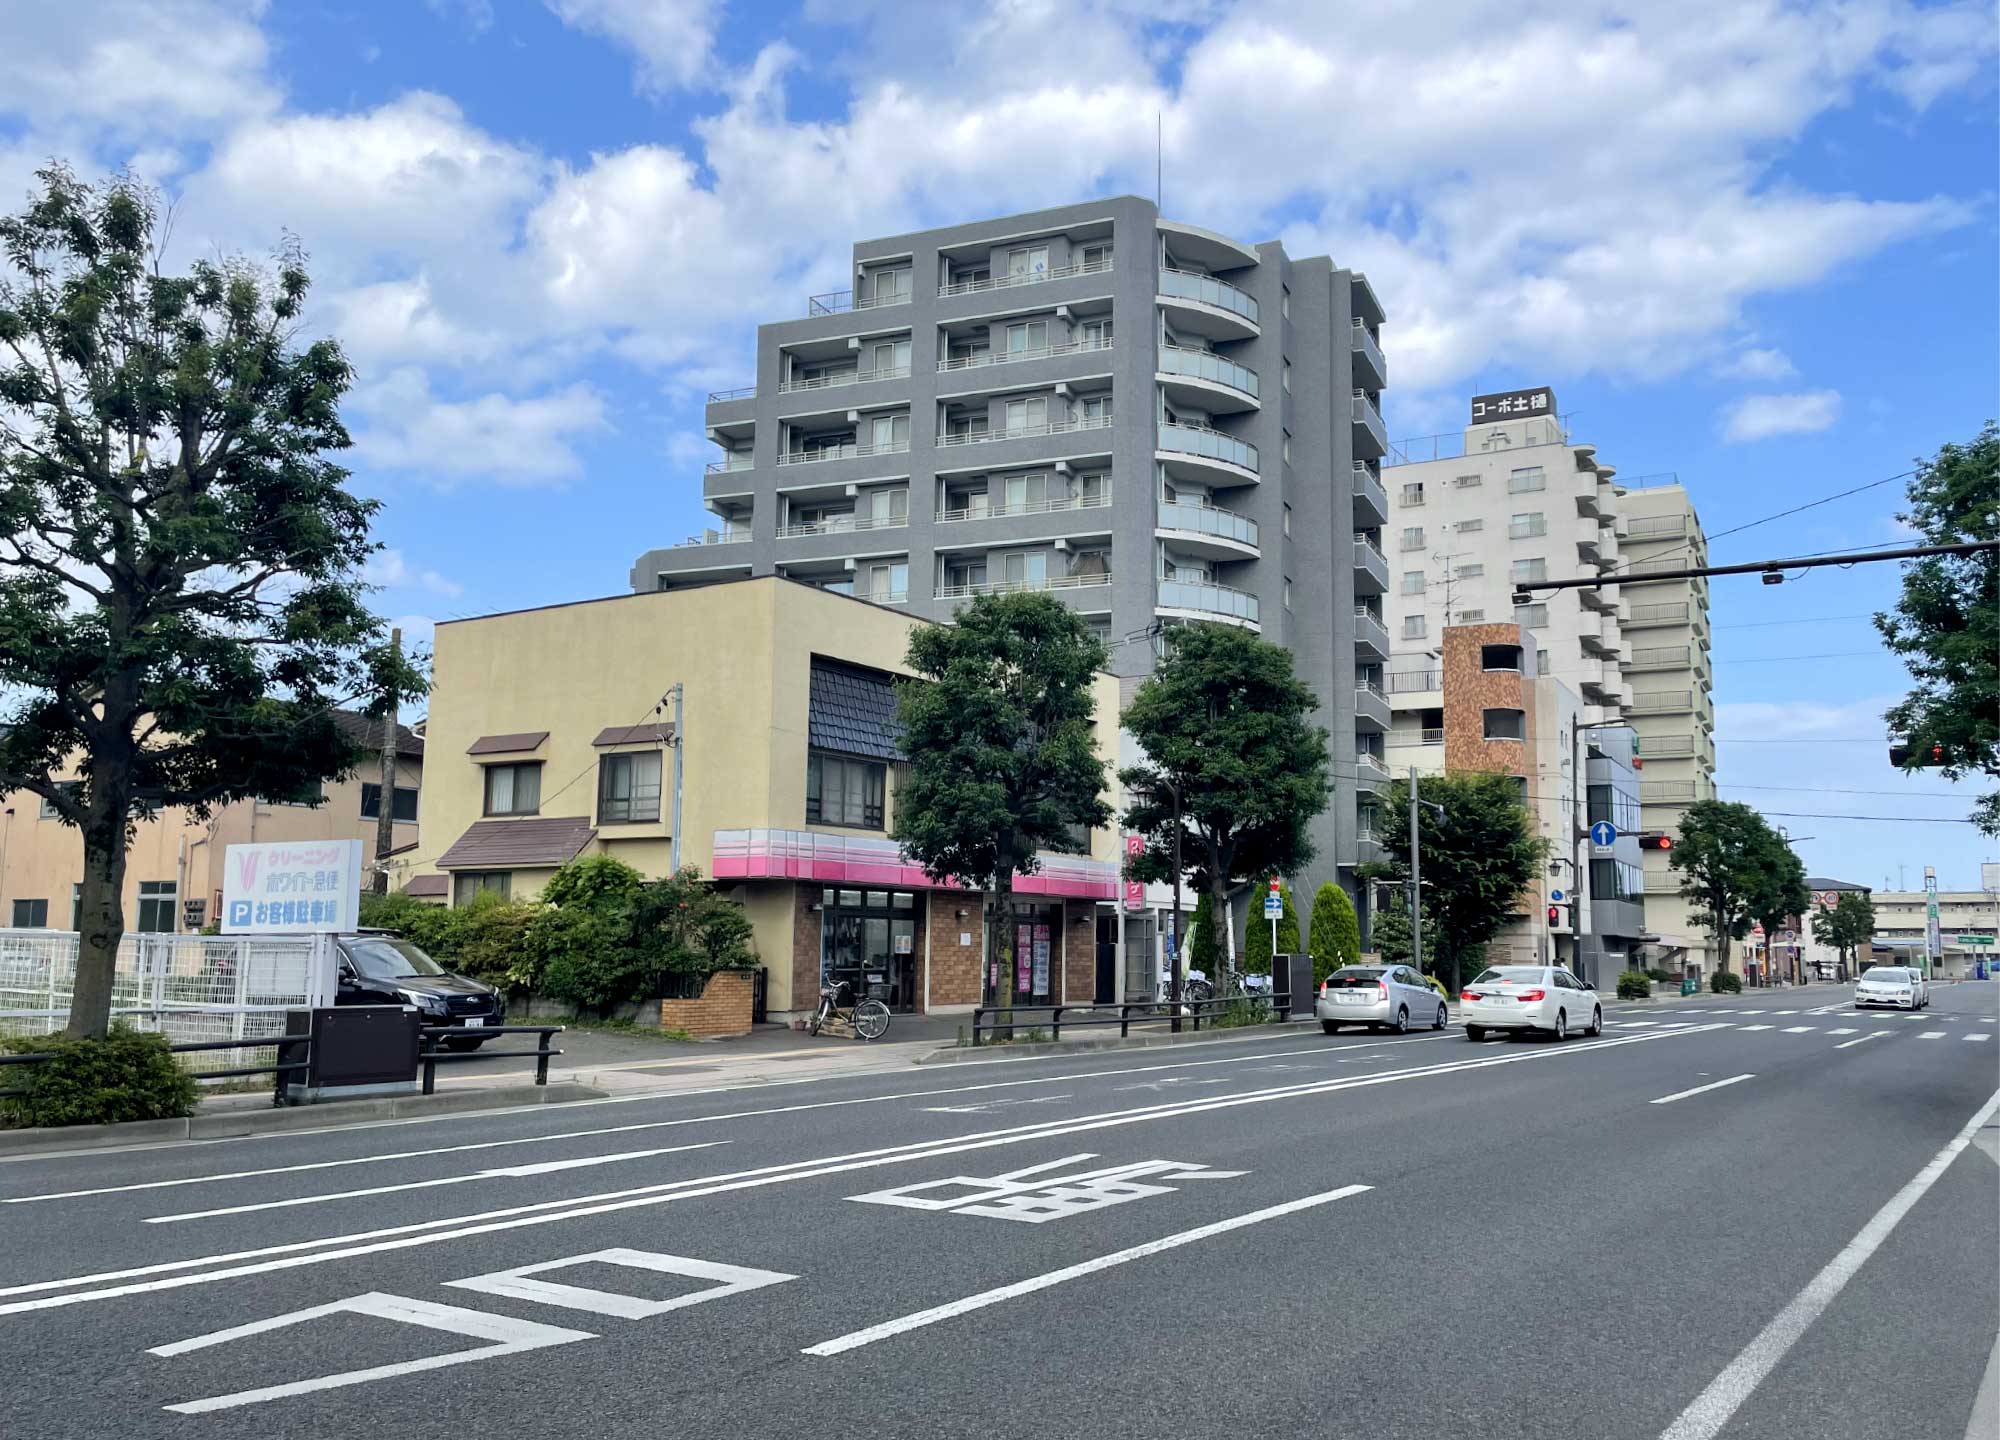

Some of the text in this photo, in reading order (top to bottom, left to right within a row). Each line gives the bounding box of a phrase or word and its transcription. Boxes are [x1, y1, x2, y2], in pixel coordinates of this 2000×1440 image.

[268, 848, 340, 866] クリーニング
[266, 871, 339, 893] ホワイト急便
[236, 905, 248, 922] P
[255, 899, 337, 925] お客様駐車場
